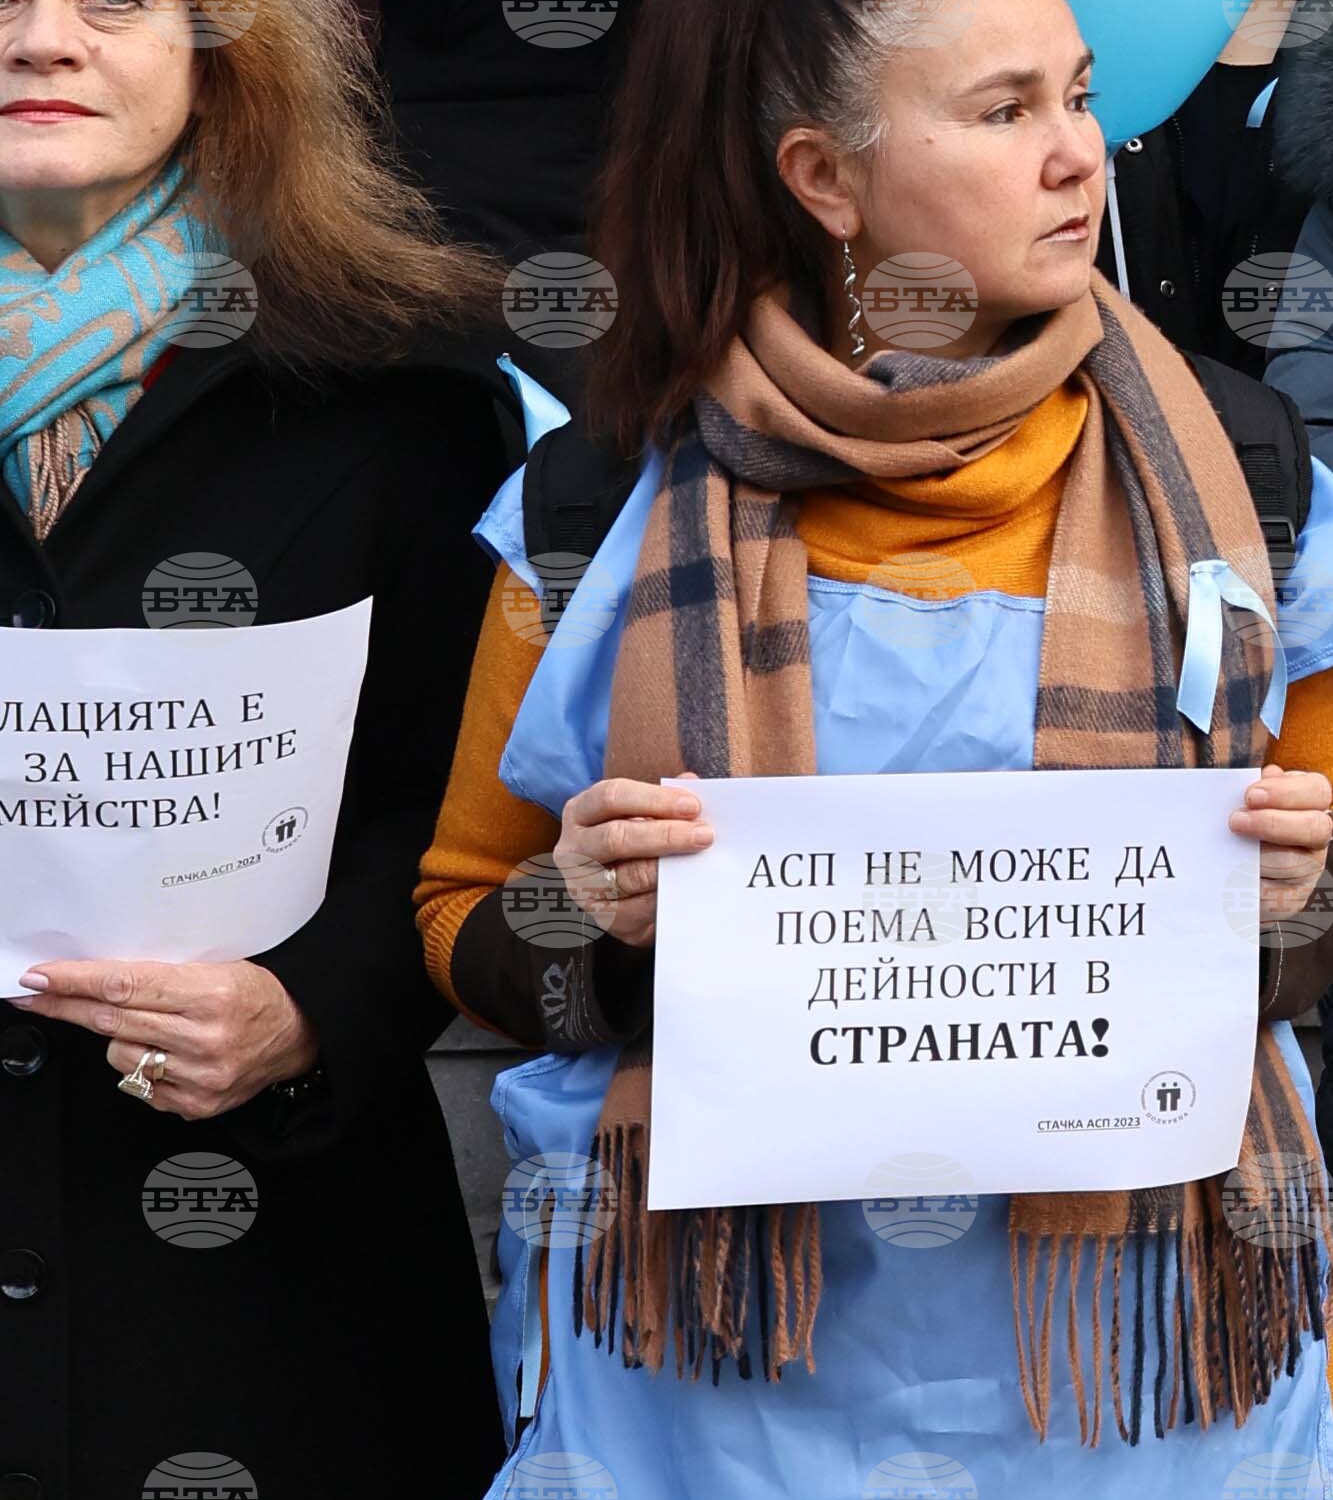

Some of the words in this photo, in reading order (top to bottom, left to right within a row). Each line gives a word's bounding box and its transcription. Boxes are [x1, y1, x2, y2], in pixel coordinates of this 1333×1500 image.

[240, 692, 264, 724] Е
[24, 753, 80, 783] ЗА
[105, 729, 297, 781] НАШИТЕ
[161, 869, 209, 888] СТАЧКА
[209, 863, 234, 878] АСП
[235, 854, 263, 870] 2023
[745, 851, 836, 889] АСП
[863, 849, 923, 886] НЕ
[948, 846, 1092, 885] МОЖЕ
[1114, 844, 1177, 888] ДА
[775, 908, 938, 946] ПОЕМА
[965, 900, 1146, 942] ВСИЧКИ
[807, 957, 1057, 1011] ДЕЙНОСТИ
[1085, 959, 1111, 995] В
[808, 1016, 1111, 1066] СТРАНАТА!
[1037, 1118, 1084, 1132] СТАЧКА
[1087, 1117, 1110, 1130] АСП
[1113, 1115, 1141, 1129] 2023
